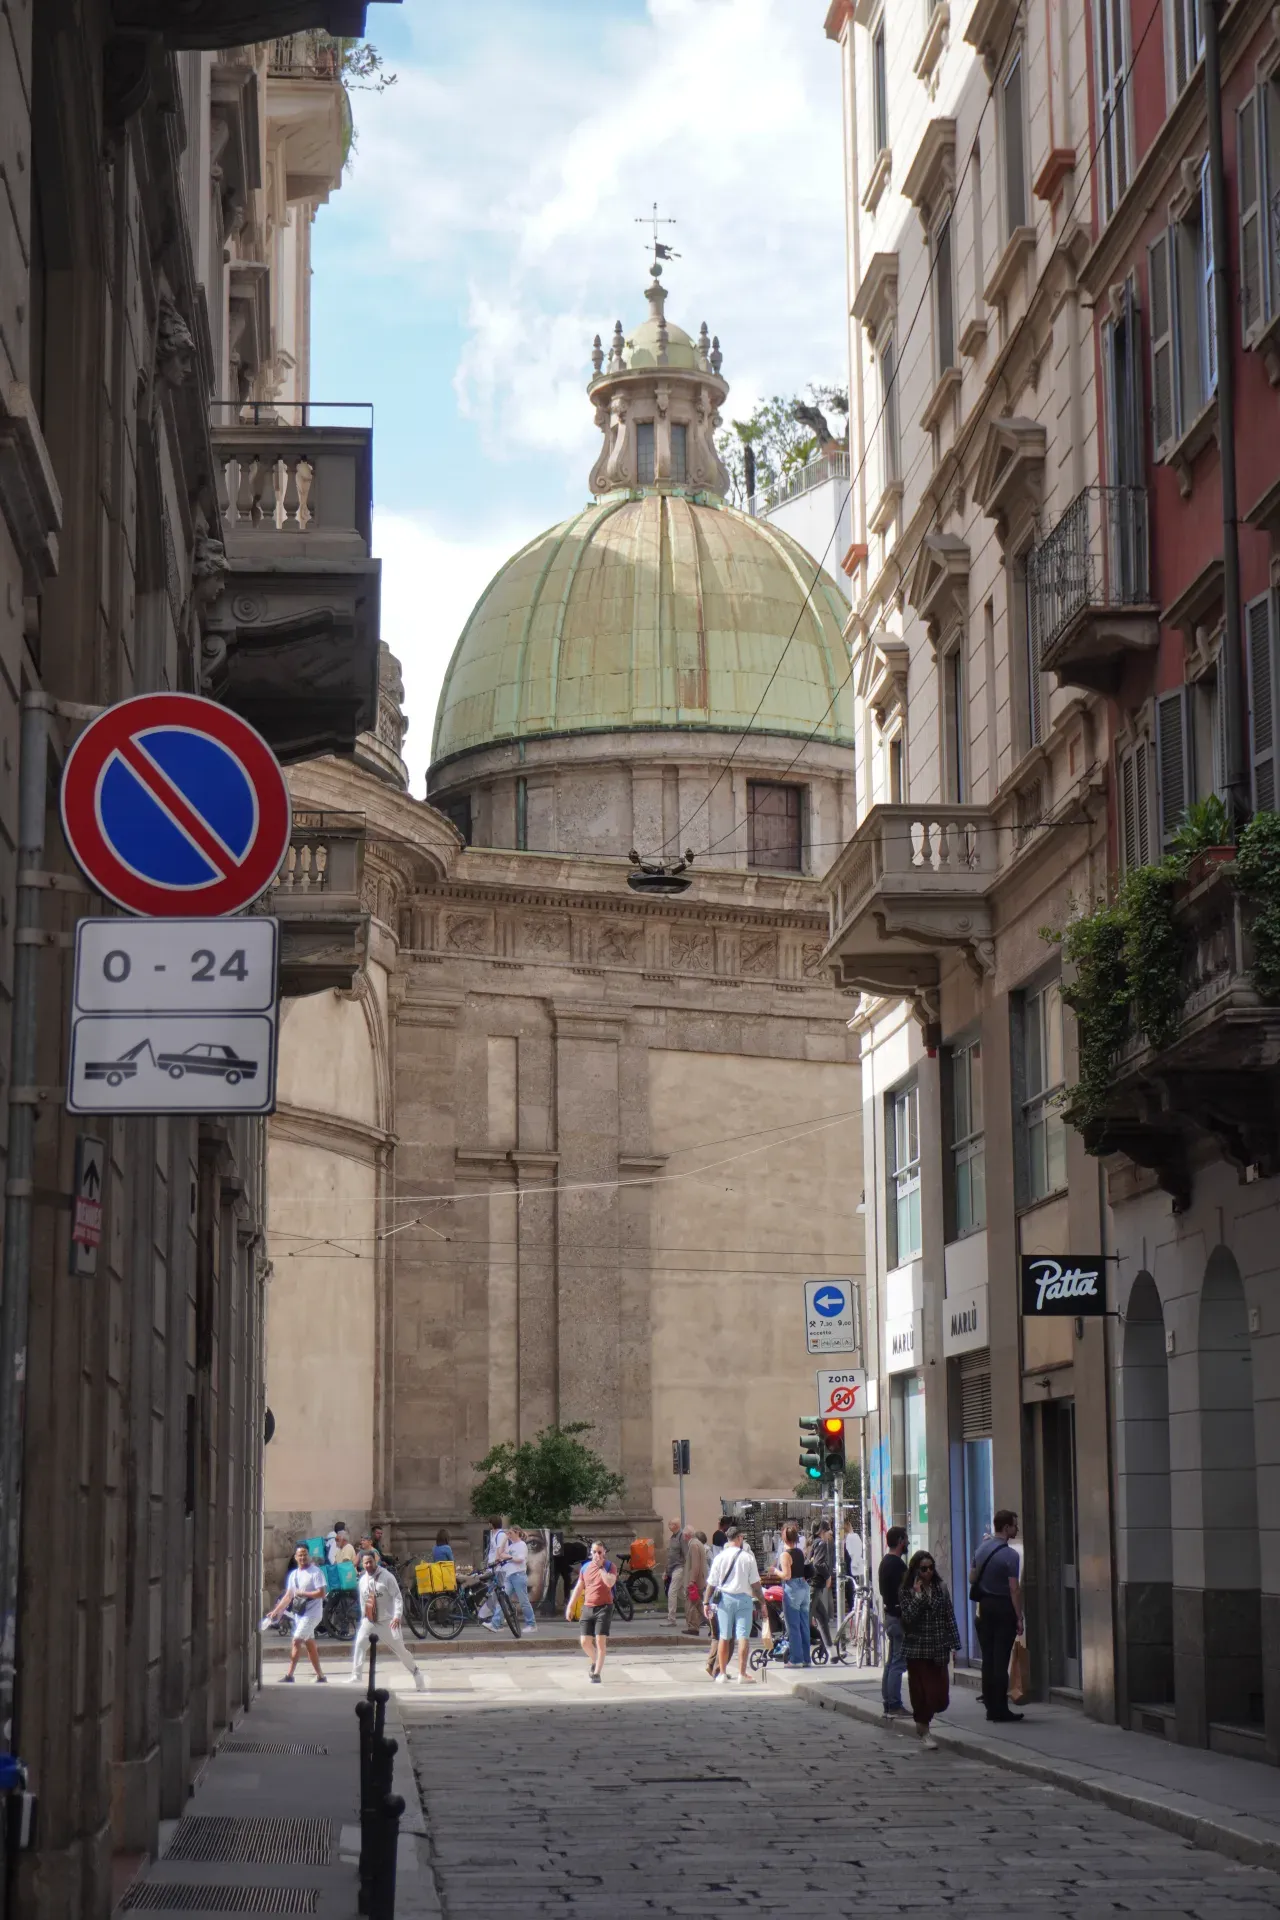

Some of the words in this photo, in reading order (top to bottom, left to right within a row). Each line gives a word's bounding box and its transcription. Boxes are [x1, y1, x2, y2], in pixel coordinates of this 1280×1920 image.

[103, 949, 132, 983] 0
[154, 964, 166, 972] -
[191, 949, 249, 982] 24
[1029, 1260, 1098, 1310] Patta
[951, 1300, 977, 1337] MARLÙ
[892, 1324, 914, 1355] MARLÙ
[828, 1375, 855, 1383] zona
